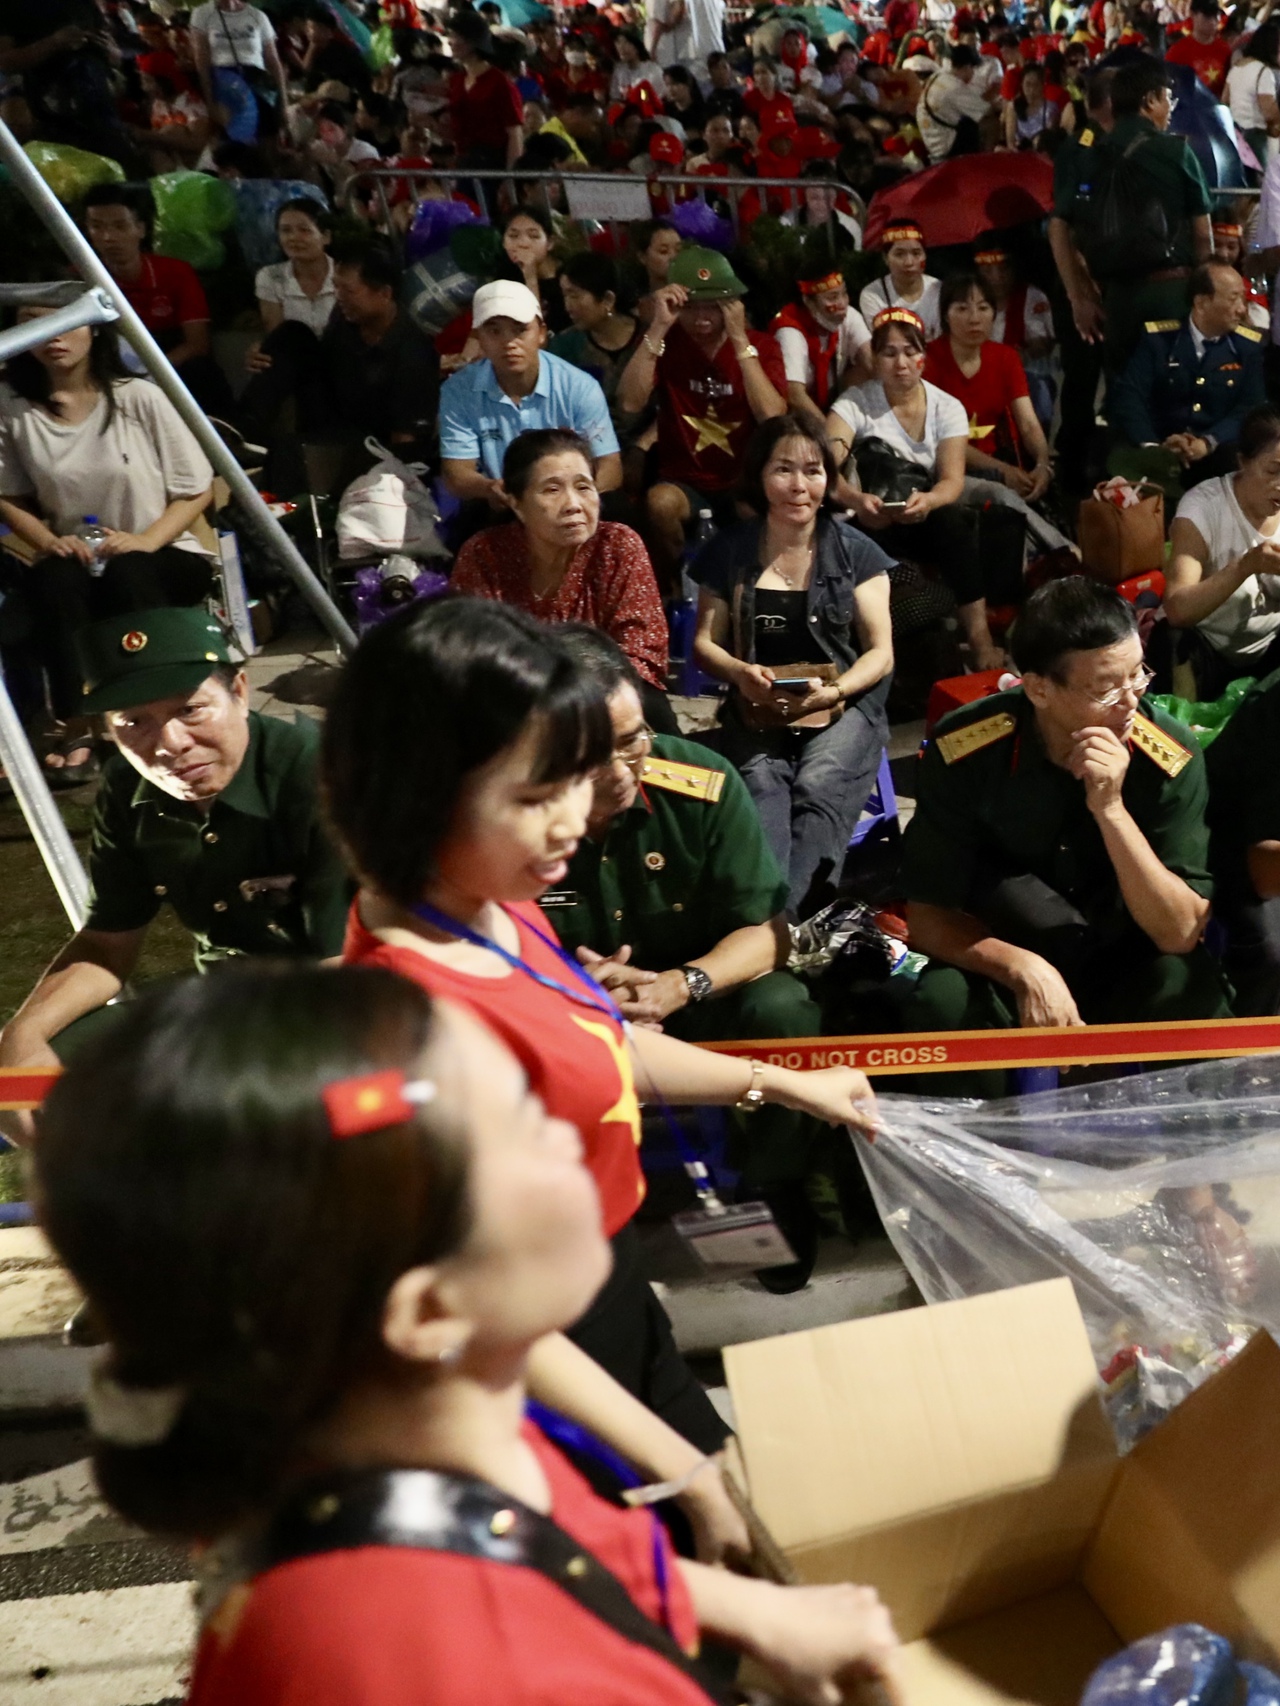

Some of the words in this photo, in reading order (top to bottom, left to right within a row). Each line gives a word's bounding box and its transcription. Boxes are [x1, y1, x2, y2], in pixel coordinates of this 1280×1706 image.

[768, 1052, 803, 1070] DO
[811, 1050, 859, 1068] NOT
[866, 1046, 948, 1066] CROSS
